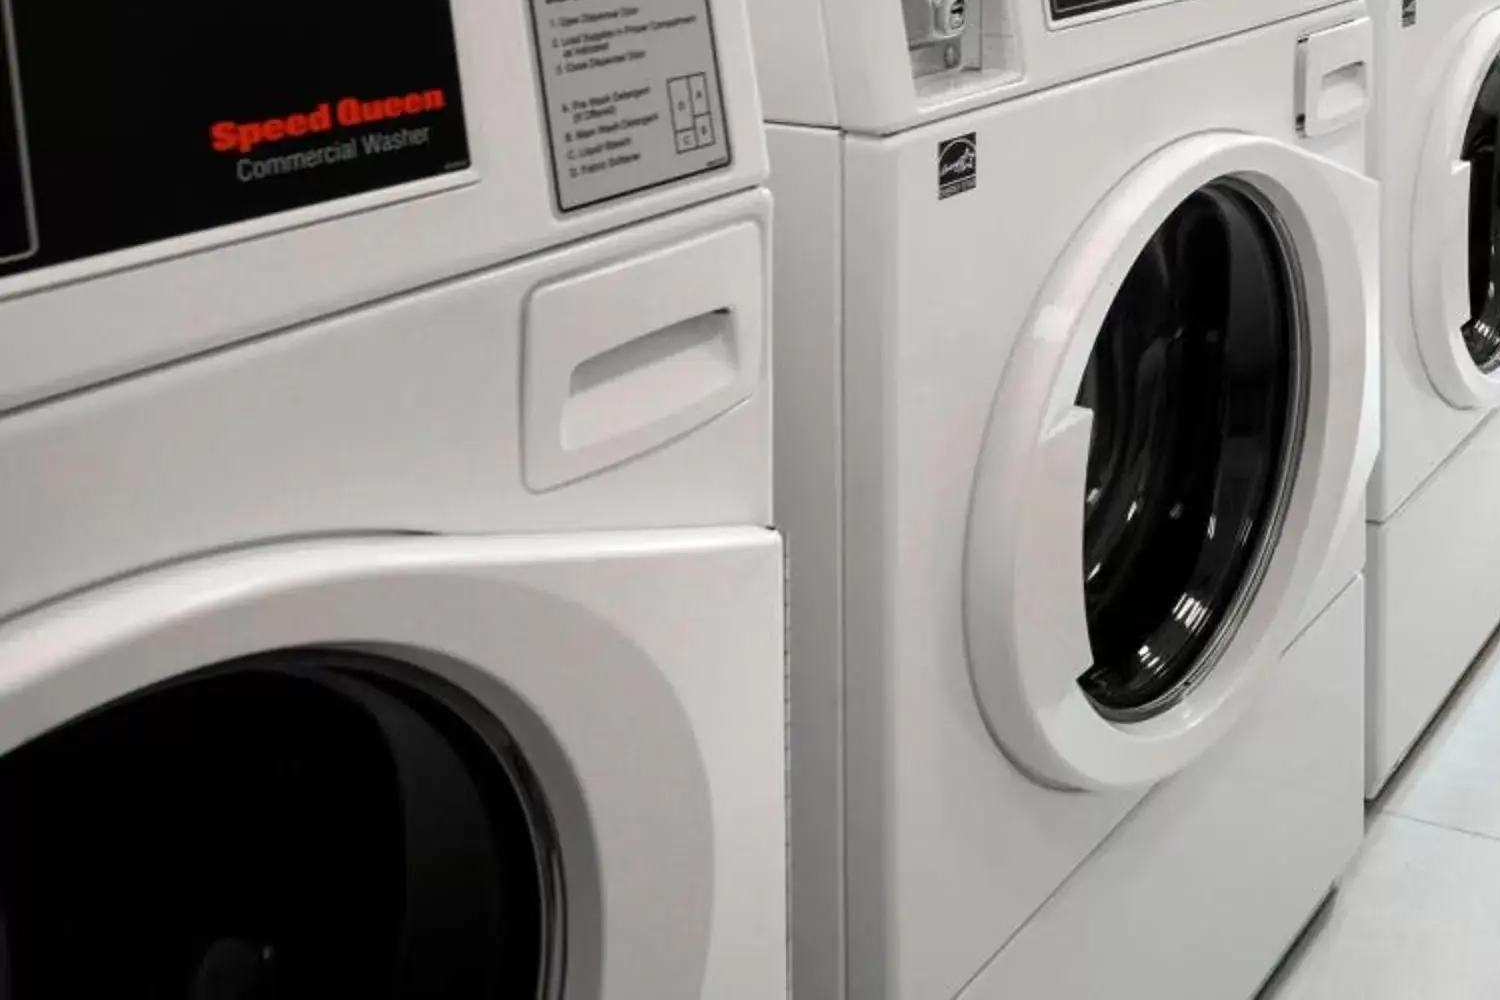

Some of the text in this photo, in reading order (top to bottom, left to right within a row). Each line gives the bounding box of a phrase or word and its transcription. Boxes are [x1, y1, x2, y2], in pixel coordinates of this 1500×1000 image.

[211, 88, 445, 152] Speed Queen
[235, 126, 430, 182] Commercial Washer
